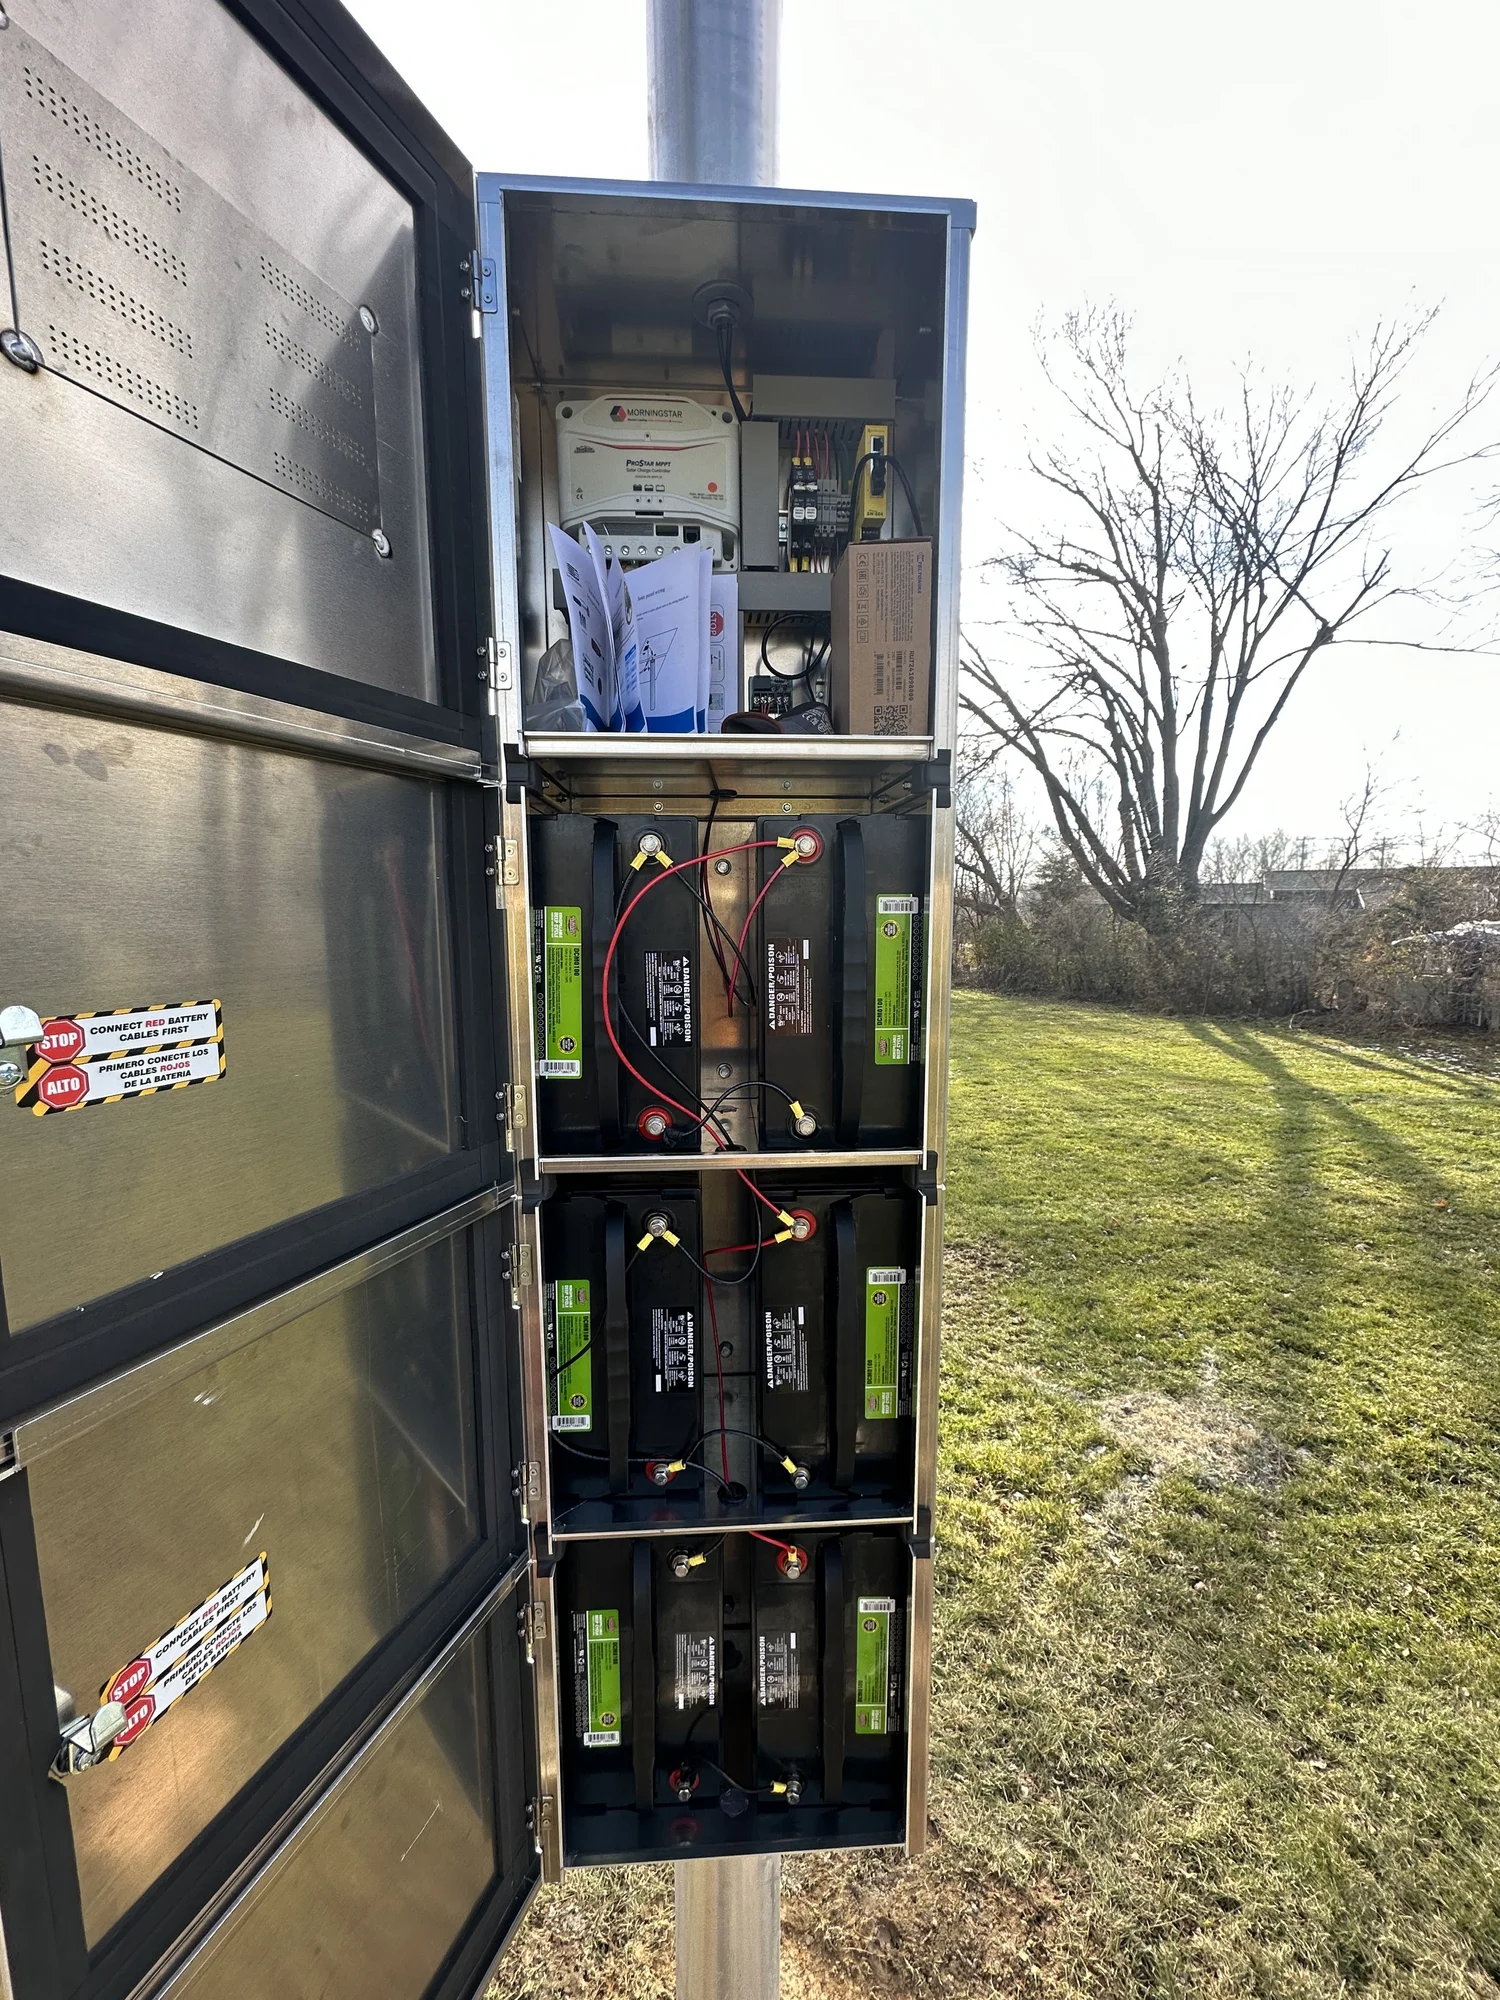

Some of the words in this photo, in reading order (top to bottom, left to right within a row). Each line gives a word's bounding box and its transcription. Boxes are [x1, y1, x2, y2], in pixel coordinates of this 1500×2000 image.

[627, 409, 682, 418] MORNINGSTAR
[768, 944, 776, 1019] DANGER/POISON
[683, 967, 691, 1042] DANGER/POISON
[41, 1032, 78, 1050] STOP
[90, 1021, 142, 1035] CONNECT
[145, 1018, 165, 1028] RED
[168, 1013, 209, 1025] BATTERY
[119, 1029, 159, 1042] CABLES
[162, 1025, 189, 1036] FIRST
[99, 1060, 144, 1074] PRIMERO
[147, 1052, 190, 1065] CONECTE
[192, 1048, 209, 1058] LOS
[120, 1066, 157, 1080] CABLES
[160, 1061, 191, 1072] ROJOS
[47, 1077, 81, 1096] ALTO
[124, 1080, 138, 1089] DE
[140, 1077, 152, 1086] LA
[154, 1070, 191, 1083] BATERIA
[765, 1311, 774, 1379] DANGER/POISON
[155, 1619, 200, 1659] CONNECT
[202, 1601, 220, 1619] RED
[221, 1569, 257, 1602] BATTERY
[180, 1615, 215, 1648] CABLES
[216, 1592, 241, 1617] FIRST
[163, 1649, 203, 1688] PRIMERO
[204, 1616, 241, 1651] CONECTE
[242, 1601, 258, 1617] LOS
[181, 1646, 214, 1680] CABLES
[215, 1623, 242, 1649] ROJOS
[185, 1673, 197, 1686] DE
[198, 1661, 209, 1675] LA
[210, 1631, 243, 1664] BATERIA
[113, 1665, 146, 1701] STOP
